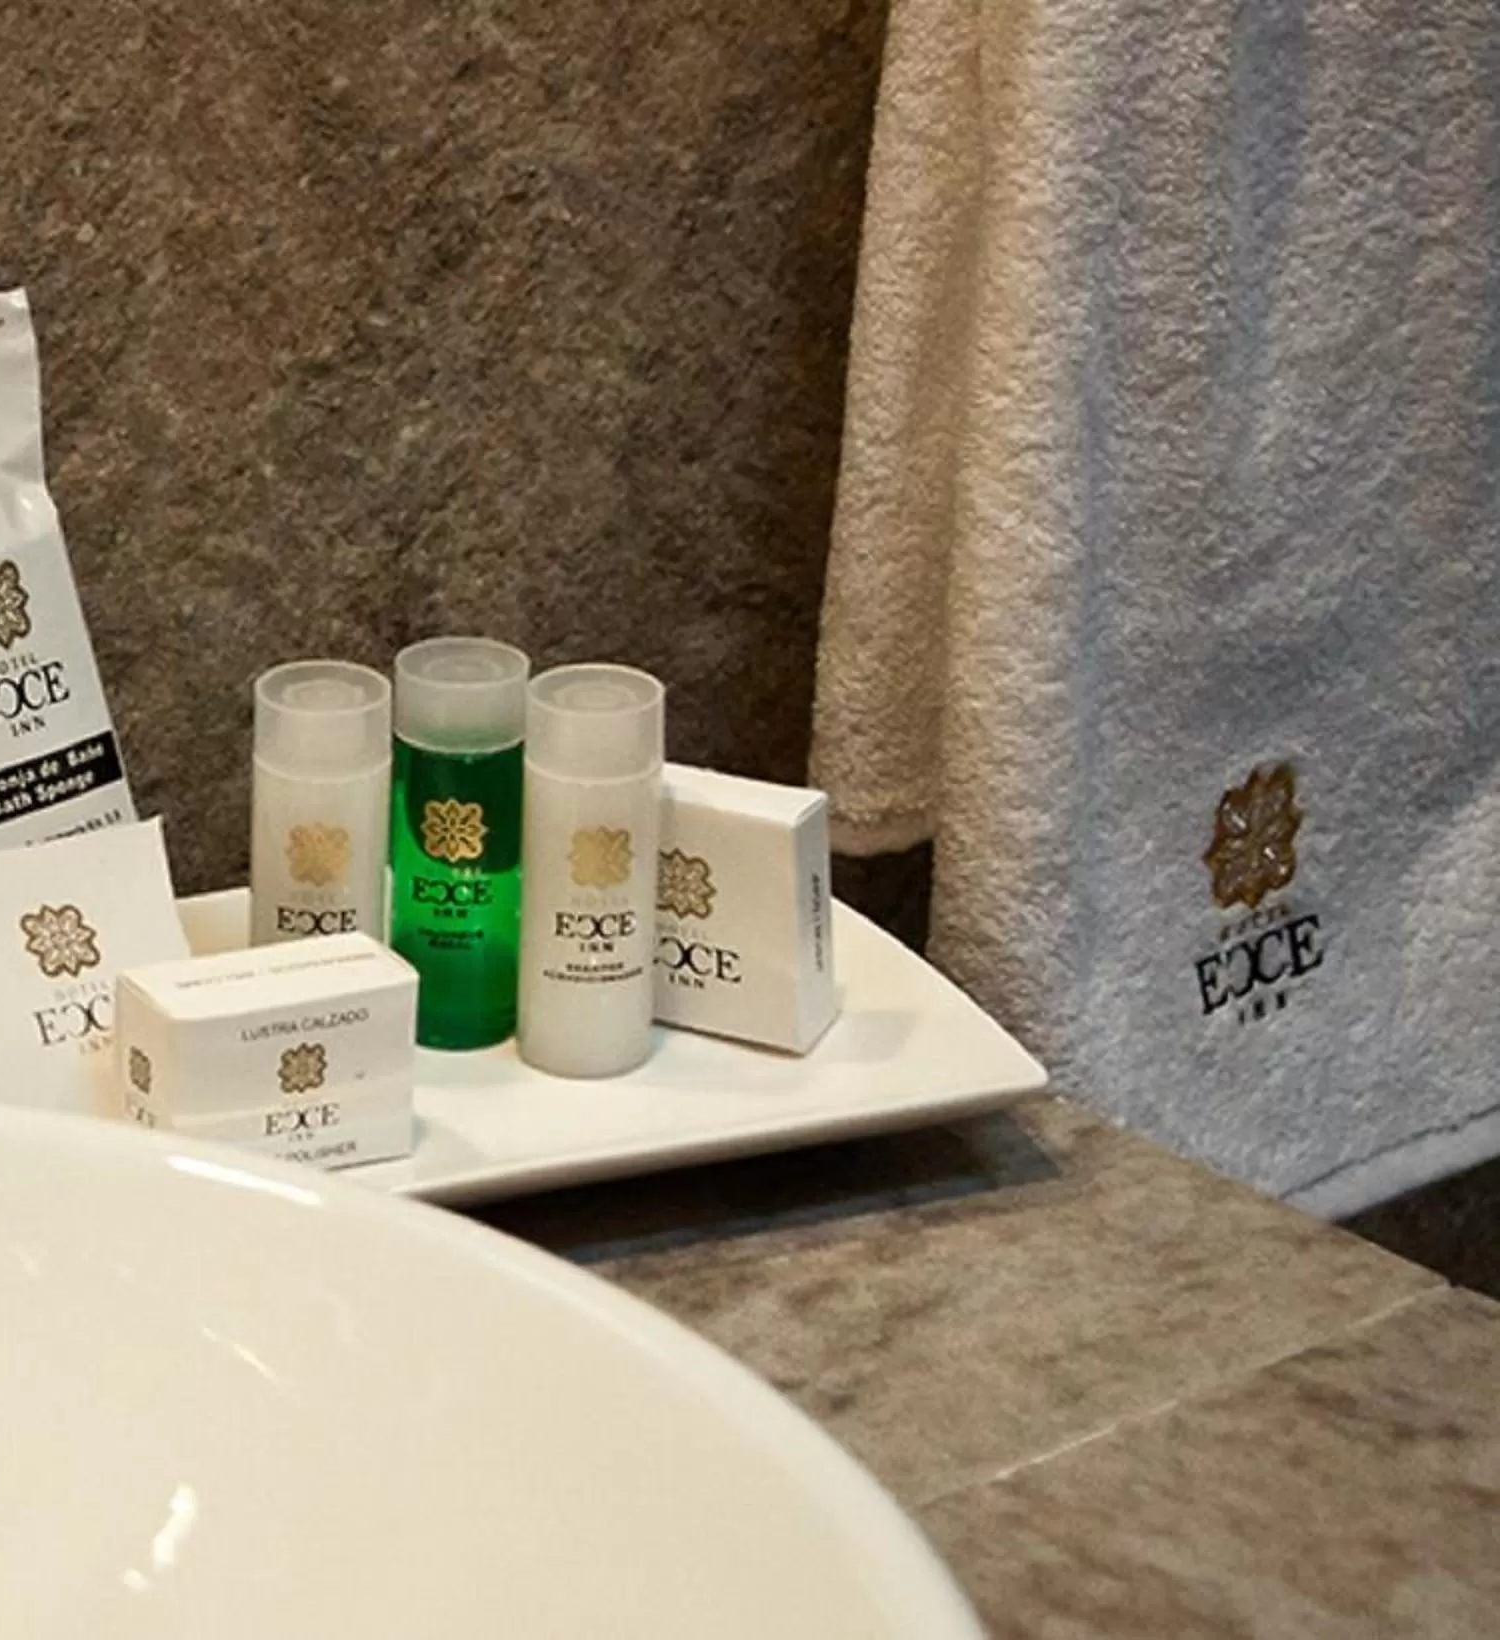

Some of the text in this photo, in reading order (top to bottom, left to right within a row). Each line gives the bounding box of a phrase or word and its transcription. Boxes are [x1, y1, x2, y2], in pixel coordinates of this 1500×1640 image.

[11, 715, 46, 738] INN
[39, 760, 58, 778] de
[35, 770, 94, 802] Sponge
[580, 942, 614, 952] INN
[653, 936, 742, 983] CCE
[668, 972, 705, 989] INN
[34, 993, 112, 1046] ECC
[240, 1007, 370, 1043] LUSTRA CALZADO
